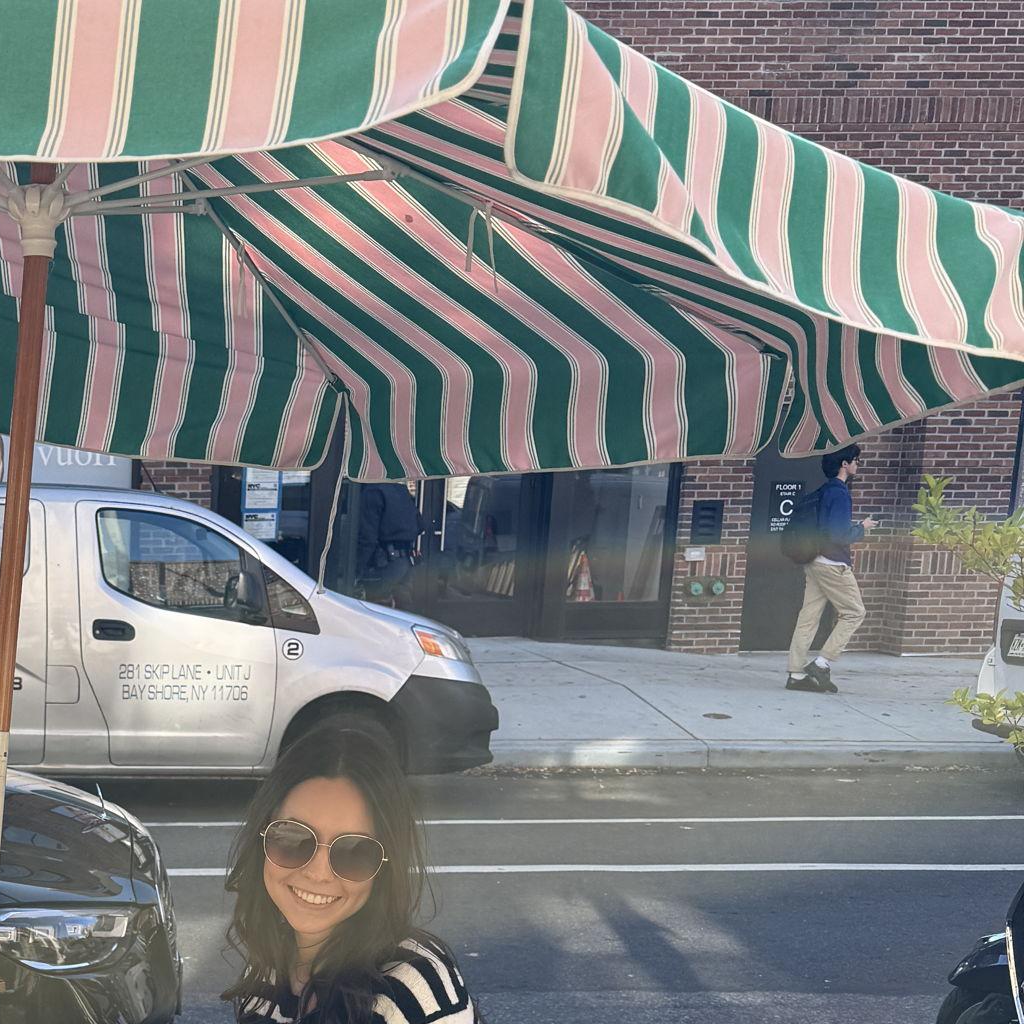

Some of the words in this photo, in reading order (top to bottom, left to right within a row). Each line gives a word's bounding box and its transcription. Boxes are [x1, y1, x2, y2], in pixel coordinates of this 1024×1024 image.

[779, 499, 794, 516] C
[286, 642, 299, 656] 2
[119, 664, 141, 680] 281
[144, 664, 170, 680] SKIP
[171, 664, 202, 680] LANE
[216, 664, 243, 680] UNIT
[244, 665, 251, 681] J
[122, 684, 146, 700] BAY
[148, 684, 189, 702] SHORE,
[191, 684, 209, 700] NY
[211, 685, 248, 700] 11706
